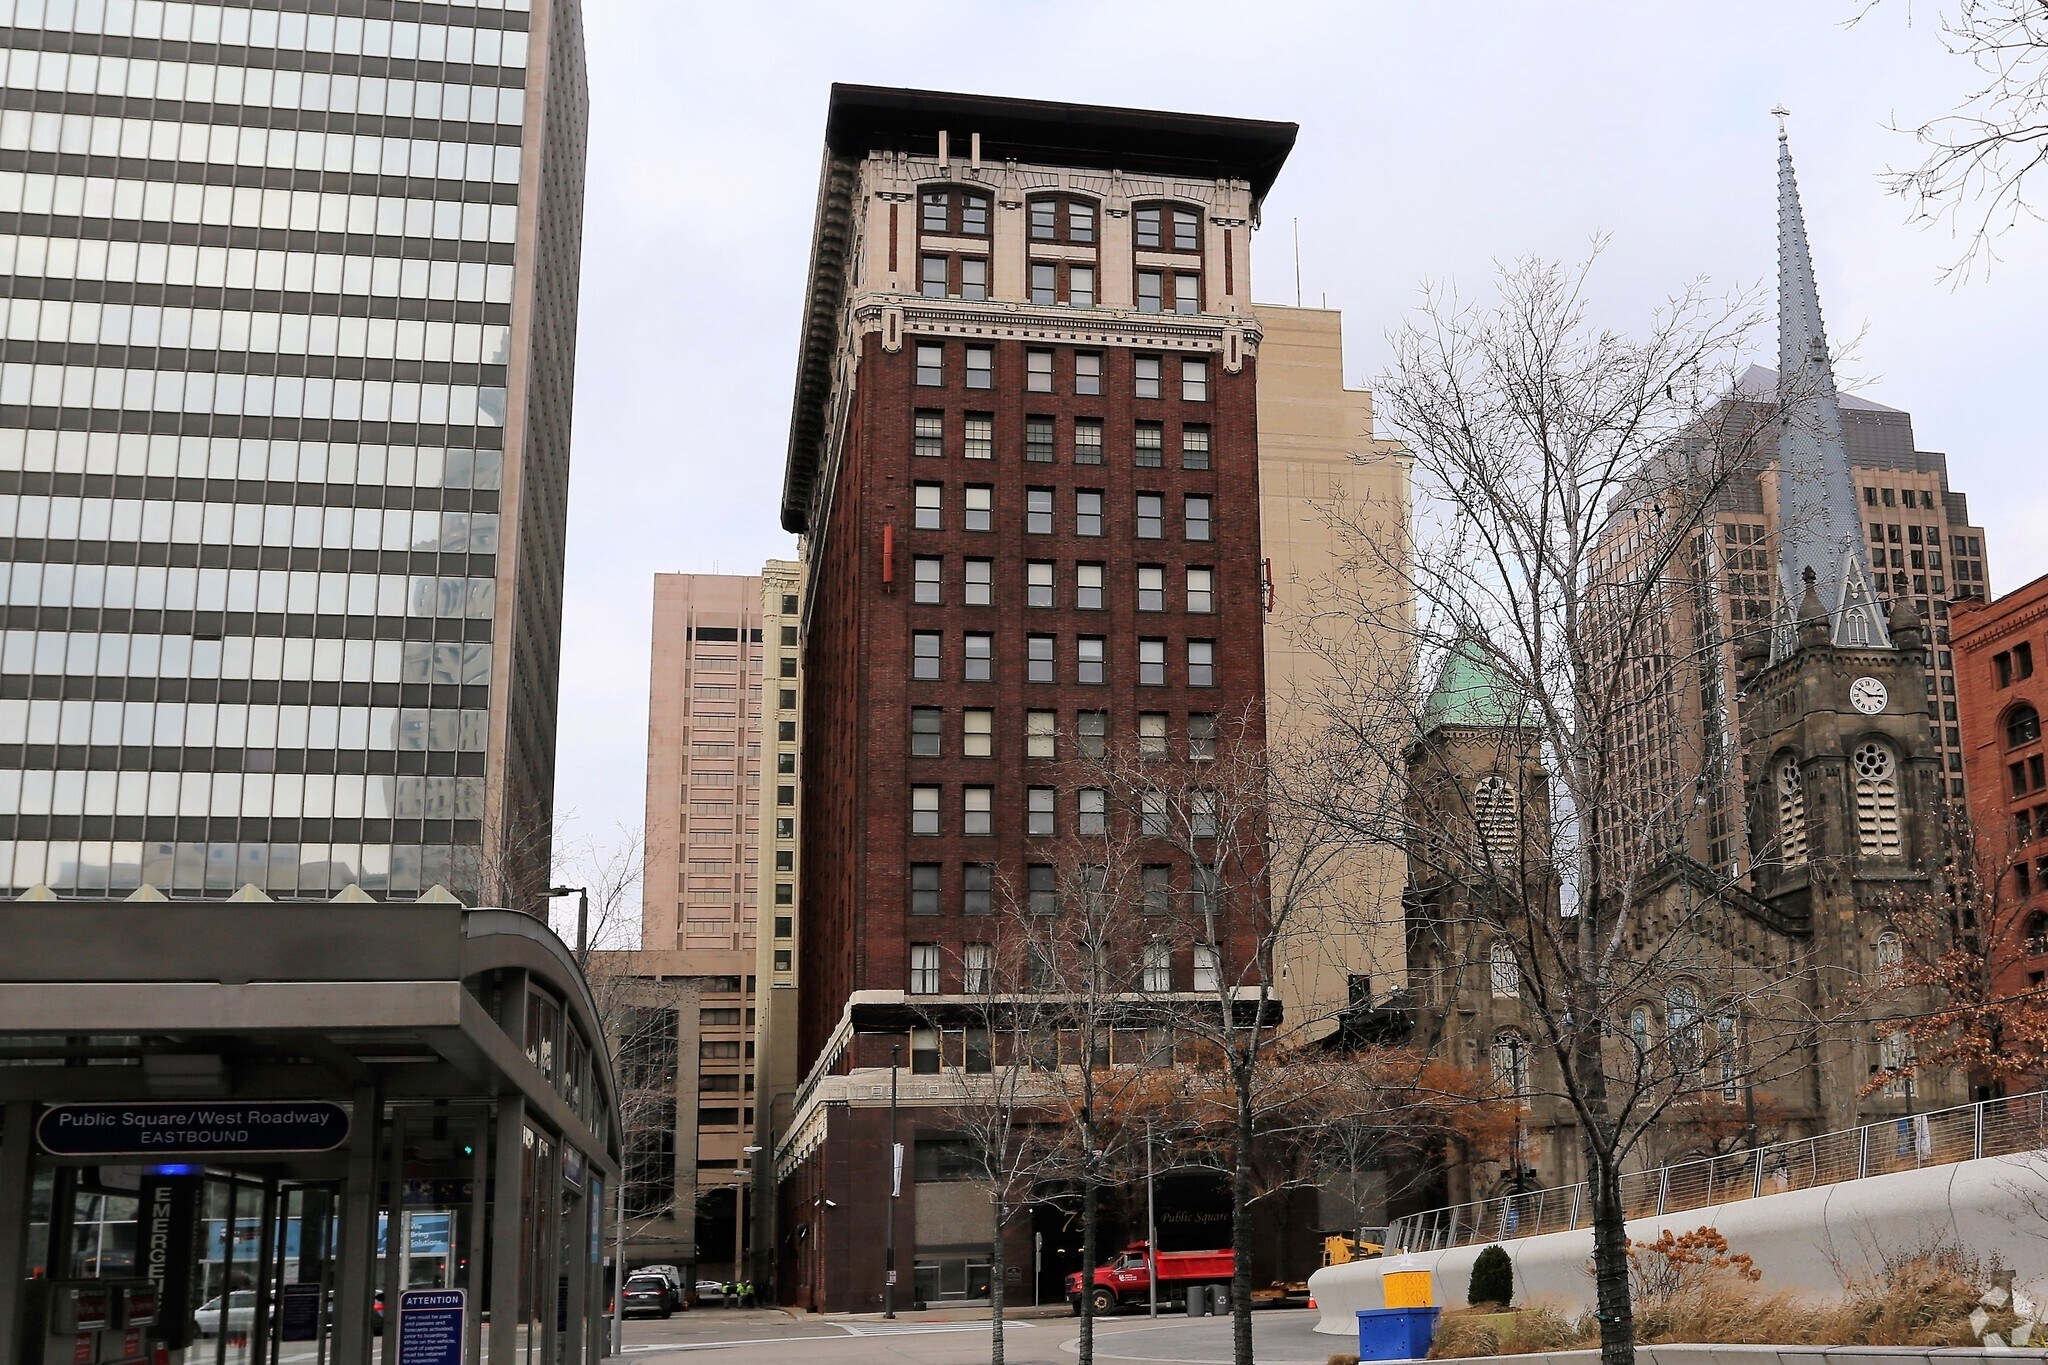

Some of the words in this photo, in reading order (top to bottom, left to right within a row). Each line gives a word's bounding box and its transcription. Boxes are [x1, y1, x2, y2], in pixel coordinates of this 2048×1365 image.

[59, 1112, 116, 1127] Public
[121, 1110, 242, 1128] Square/West
[248, 1110, 330, 1127] Roadway
[140, 1130, 249, 1144] EASTBOUND
[1162, 1210, 1192, 1223] Public
[1195, 1211, 1229, 1225] Square
[411, 1231, 429, 1239] Bring
[406, 1296, 459, 1305] ATTENTION
